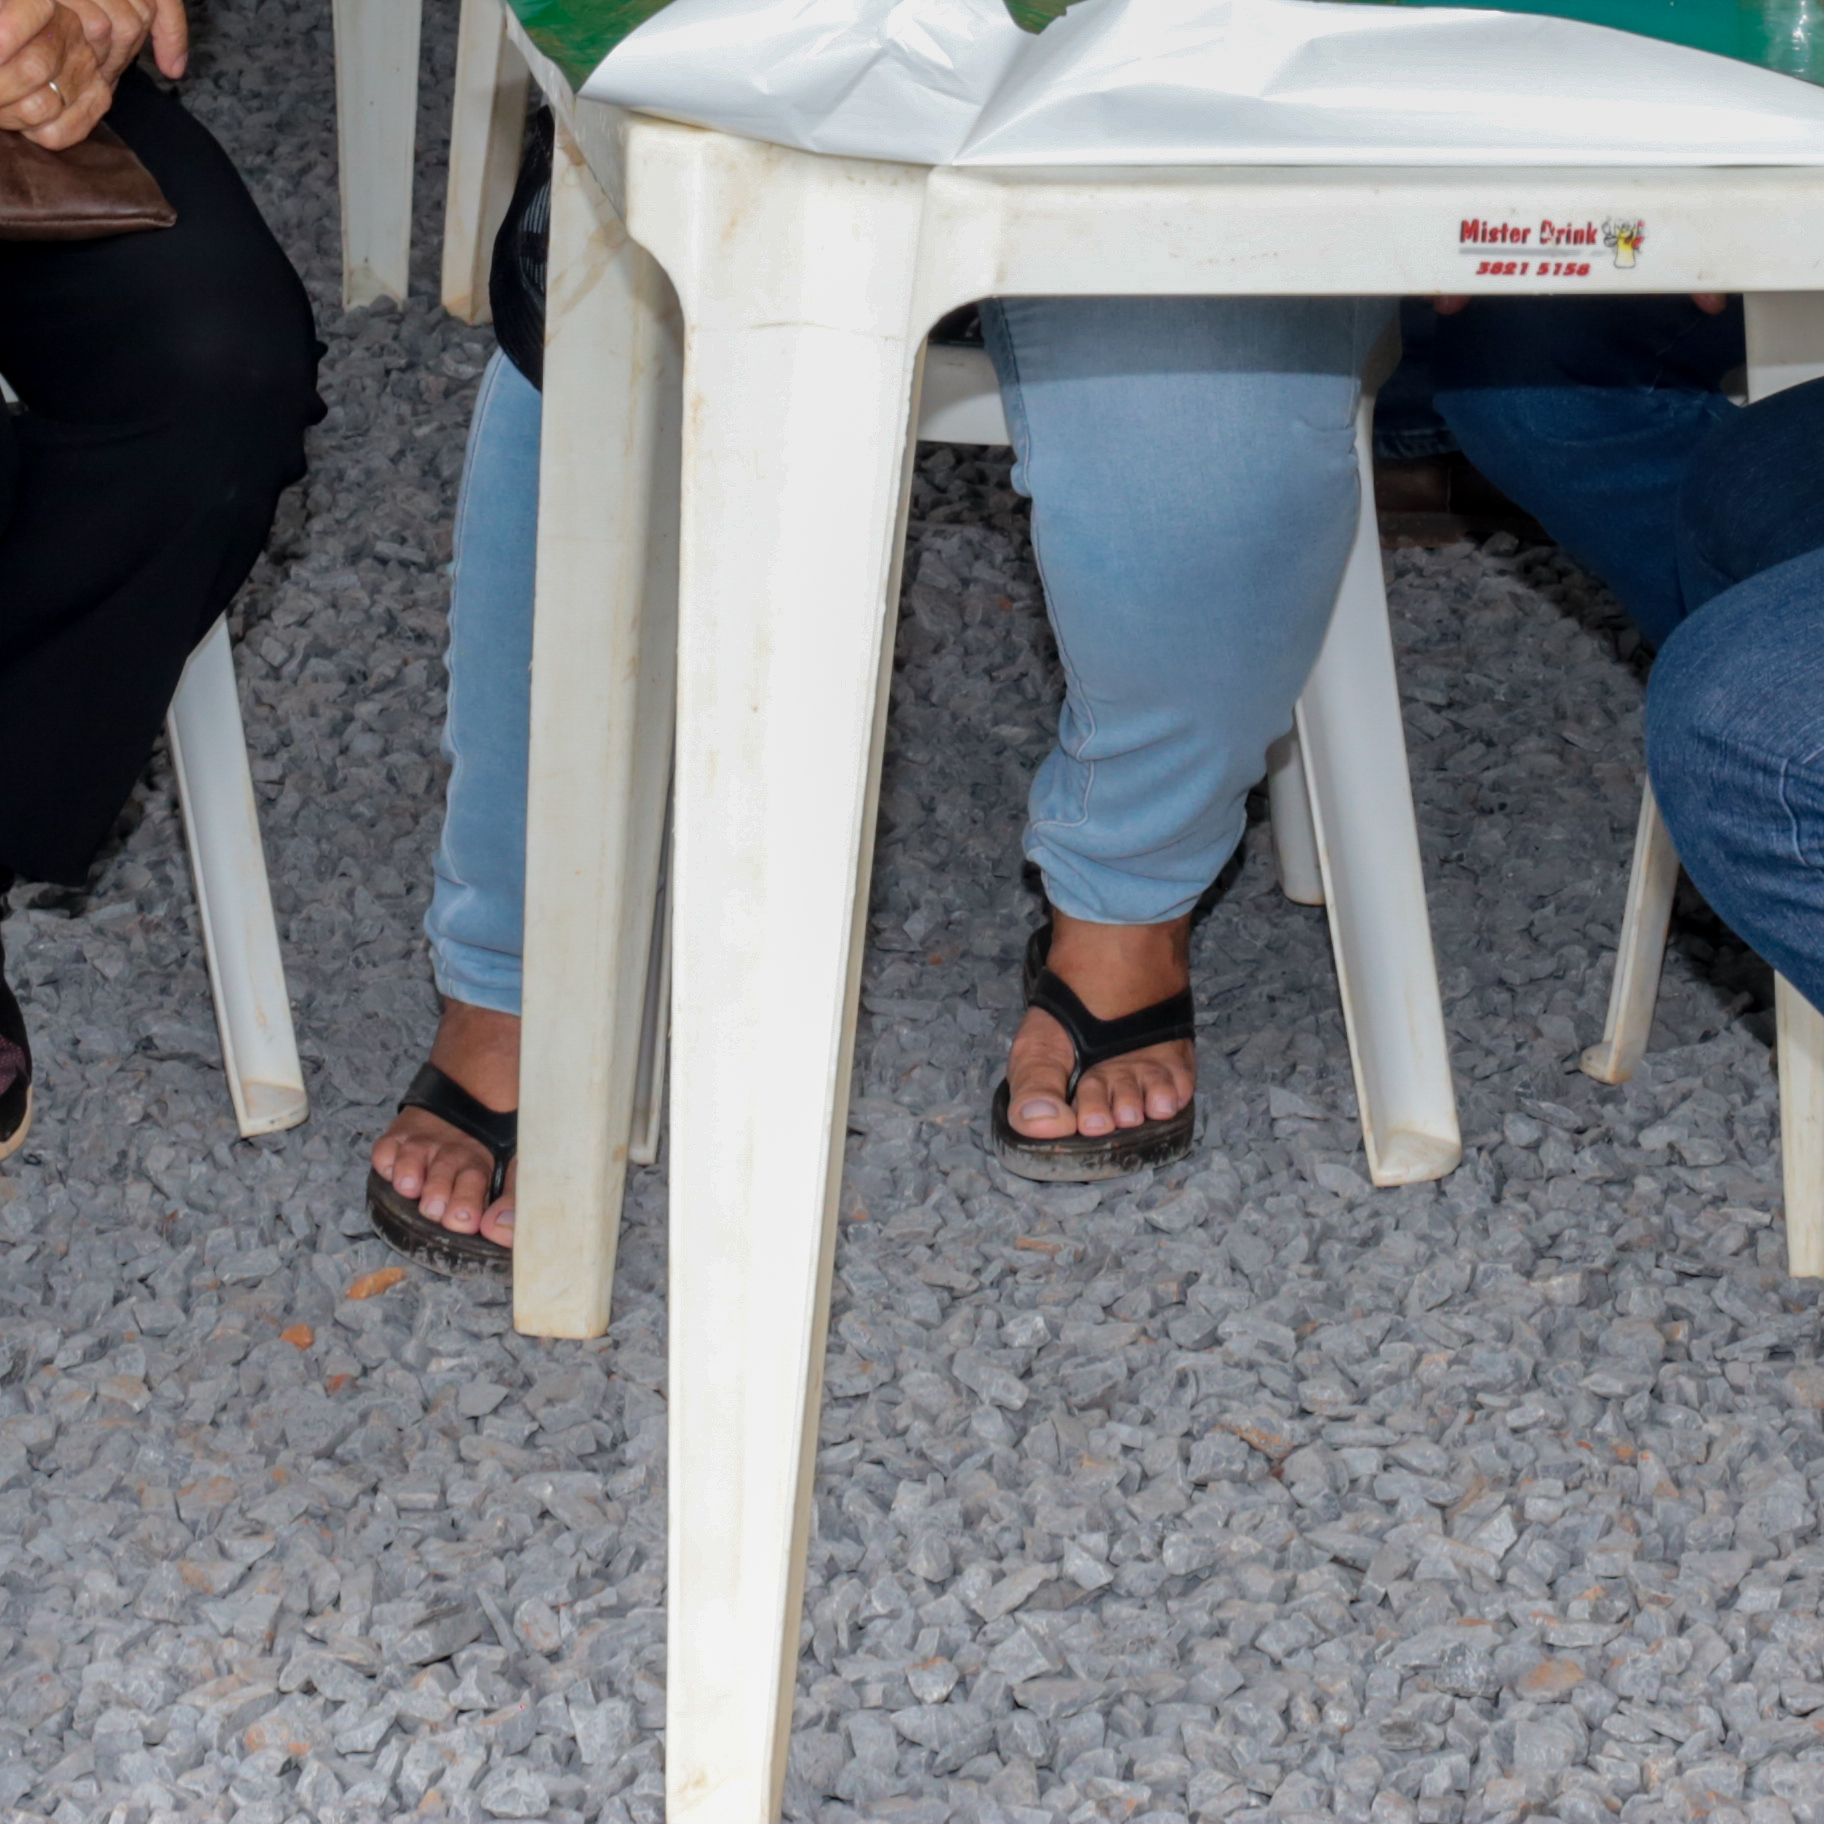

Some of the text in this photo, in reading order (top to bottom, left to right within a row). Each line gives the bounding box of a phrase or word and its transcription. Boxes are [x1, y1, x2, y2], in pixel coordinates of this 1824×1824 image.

[1460, 218, 1598, 245] Mister Drink
[1476, 261, 1591, 277] 3821 5158
